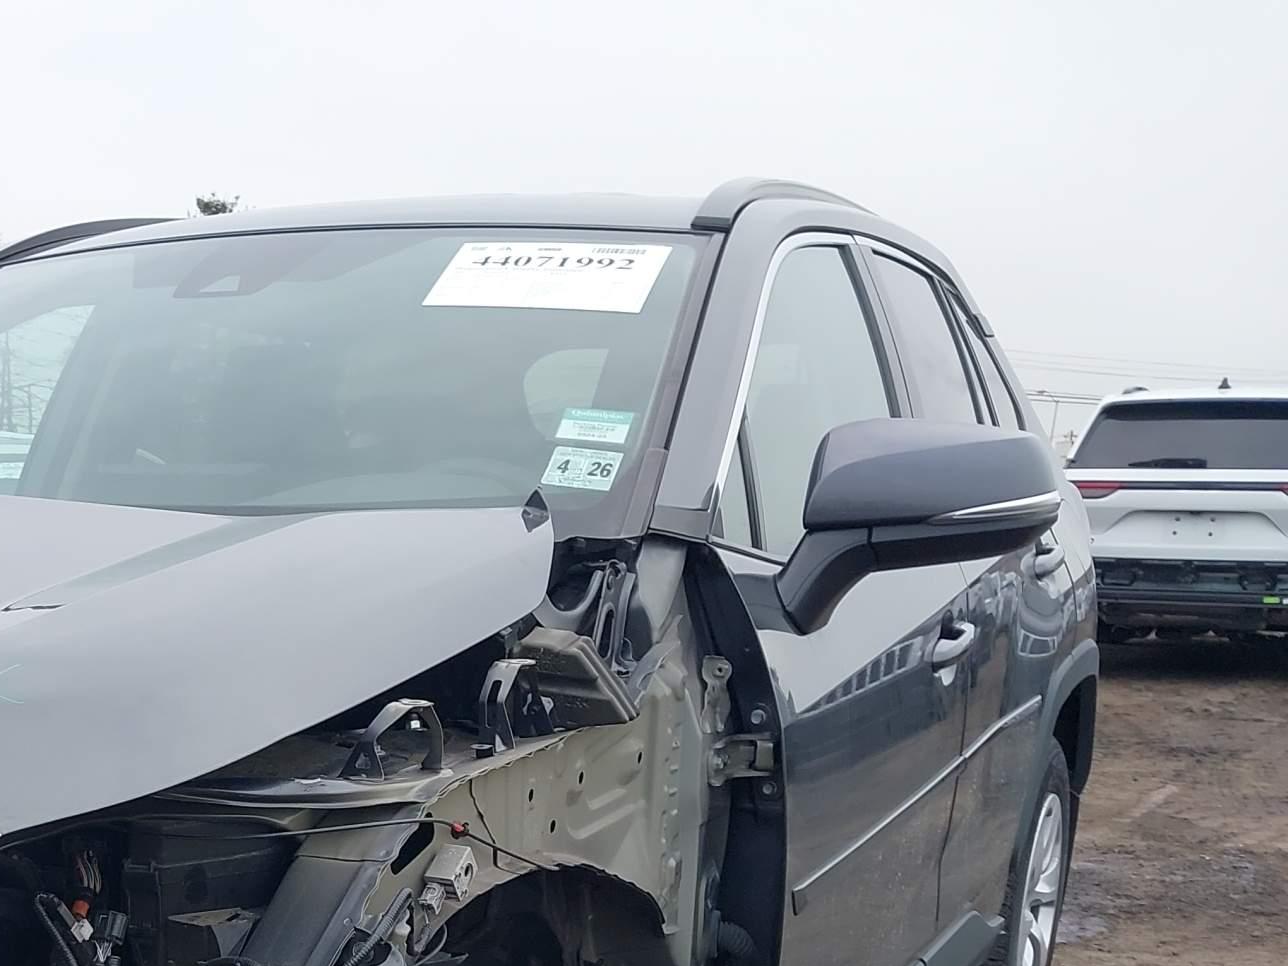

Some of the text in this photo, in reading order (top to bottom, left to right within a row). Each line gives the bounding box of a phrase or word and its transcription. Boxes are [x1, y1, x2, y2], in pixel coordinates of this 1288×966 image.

[471, 255, 636, 270] 44071992
[556, 459, 613, 478] 4 26
